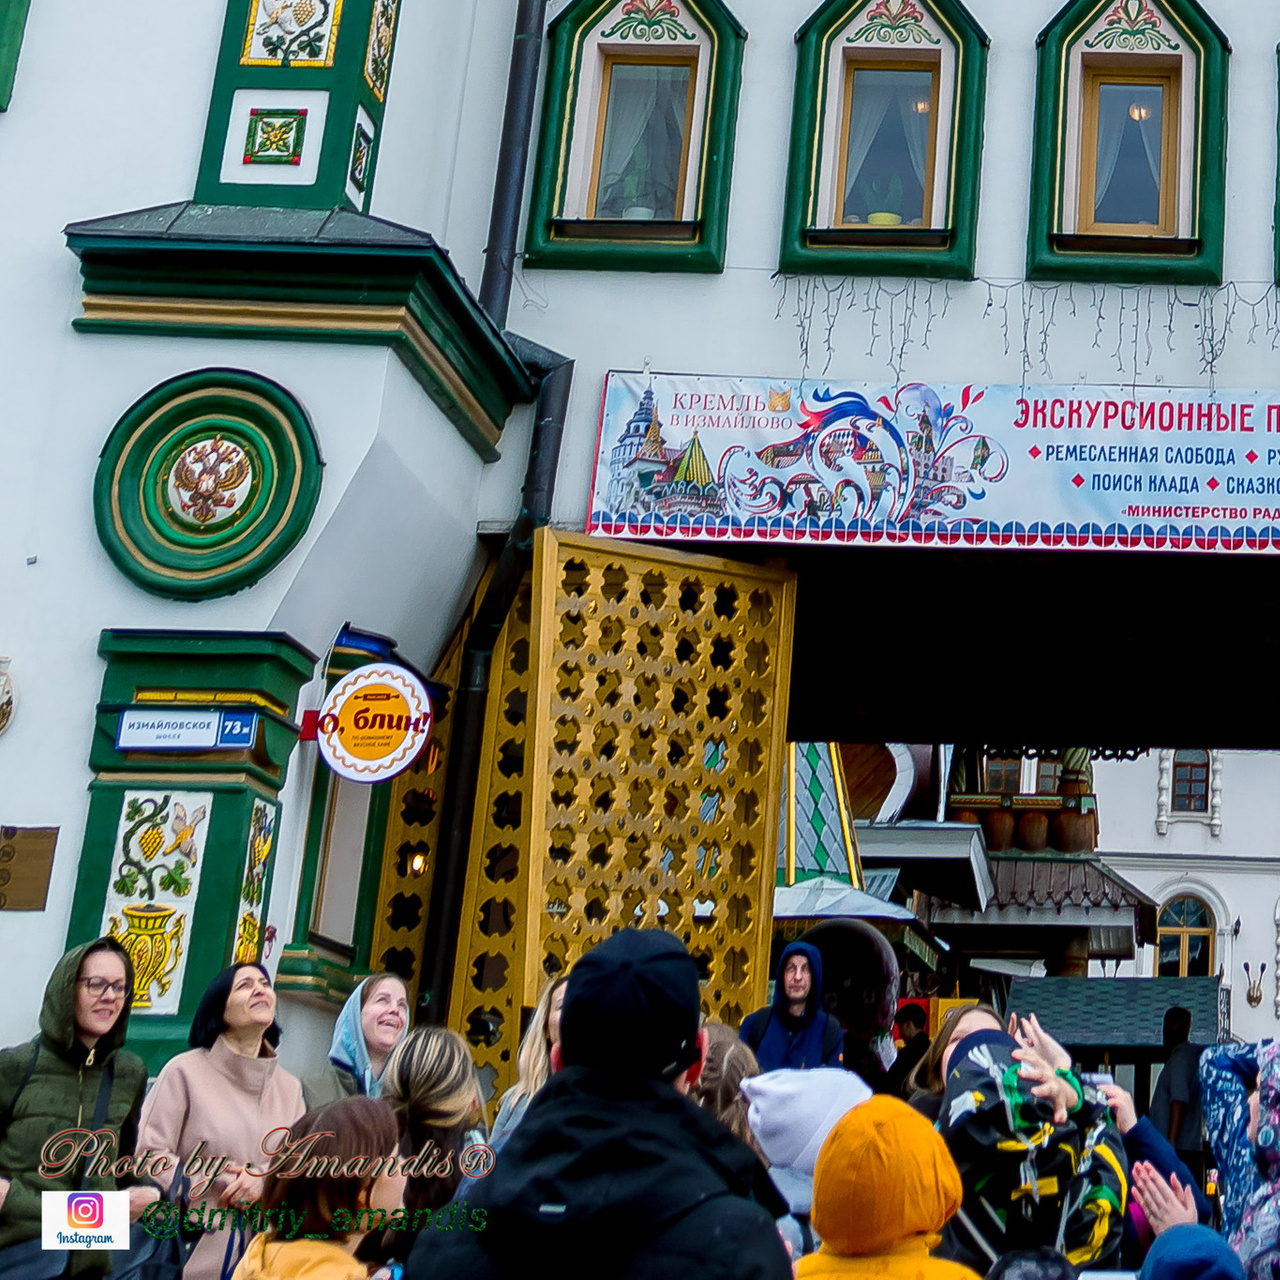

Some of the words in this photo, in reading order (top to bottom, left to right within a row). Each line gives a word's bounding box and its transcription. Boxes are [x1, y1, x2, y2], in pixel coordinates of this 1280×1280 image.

[671, 392, 767, 412] КРЕМЛЬ
[669, 413, 680, 426] В
[684, 413, 793, 430] ИЗМАЙЛОВО
[1013, 397, 1255, 433] ЭКСКУРСИОННЫЕ
[1045, 444, 1159, 464] РЕМЕСЛЕННАЯ
[1164, 446, 1236, 466] СЛОБОДА
[1091, 473, 1143, 492] ПОИСК
[1149, 475, 1200, 494] КЛАДА
[1120, 504, 1249, 520] «МИНИСТЕРСТВО
[127, 719, 213, 731] ИЗМАЙЛОВСКОЕ
[353, 706, 431, 734] блин!
